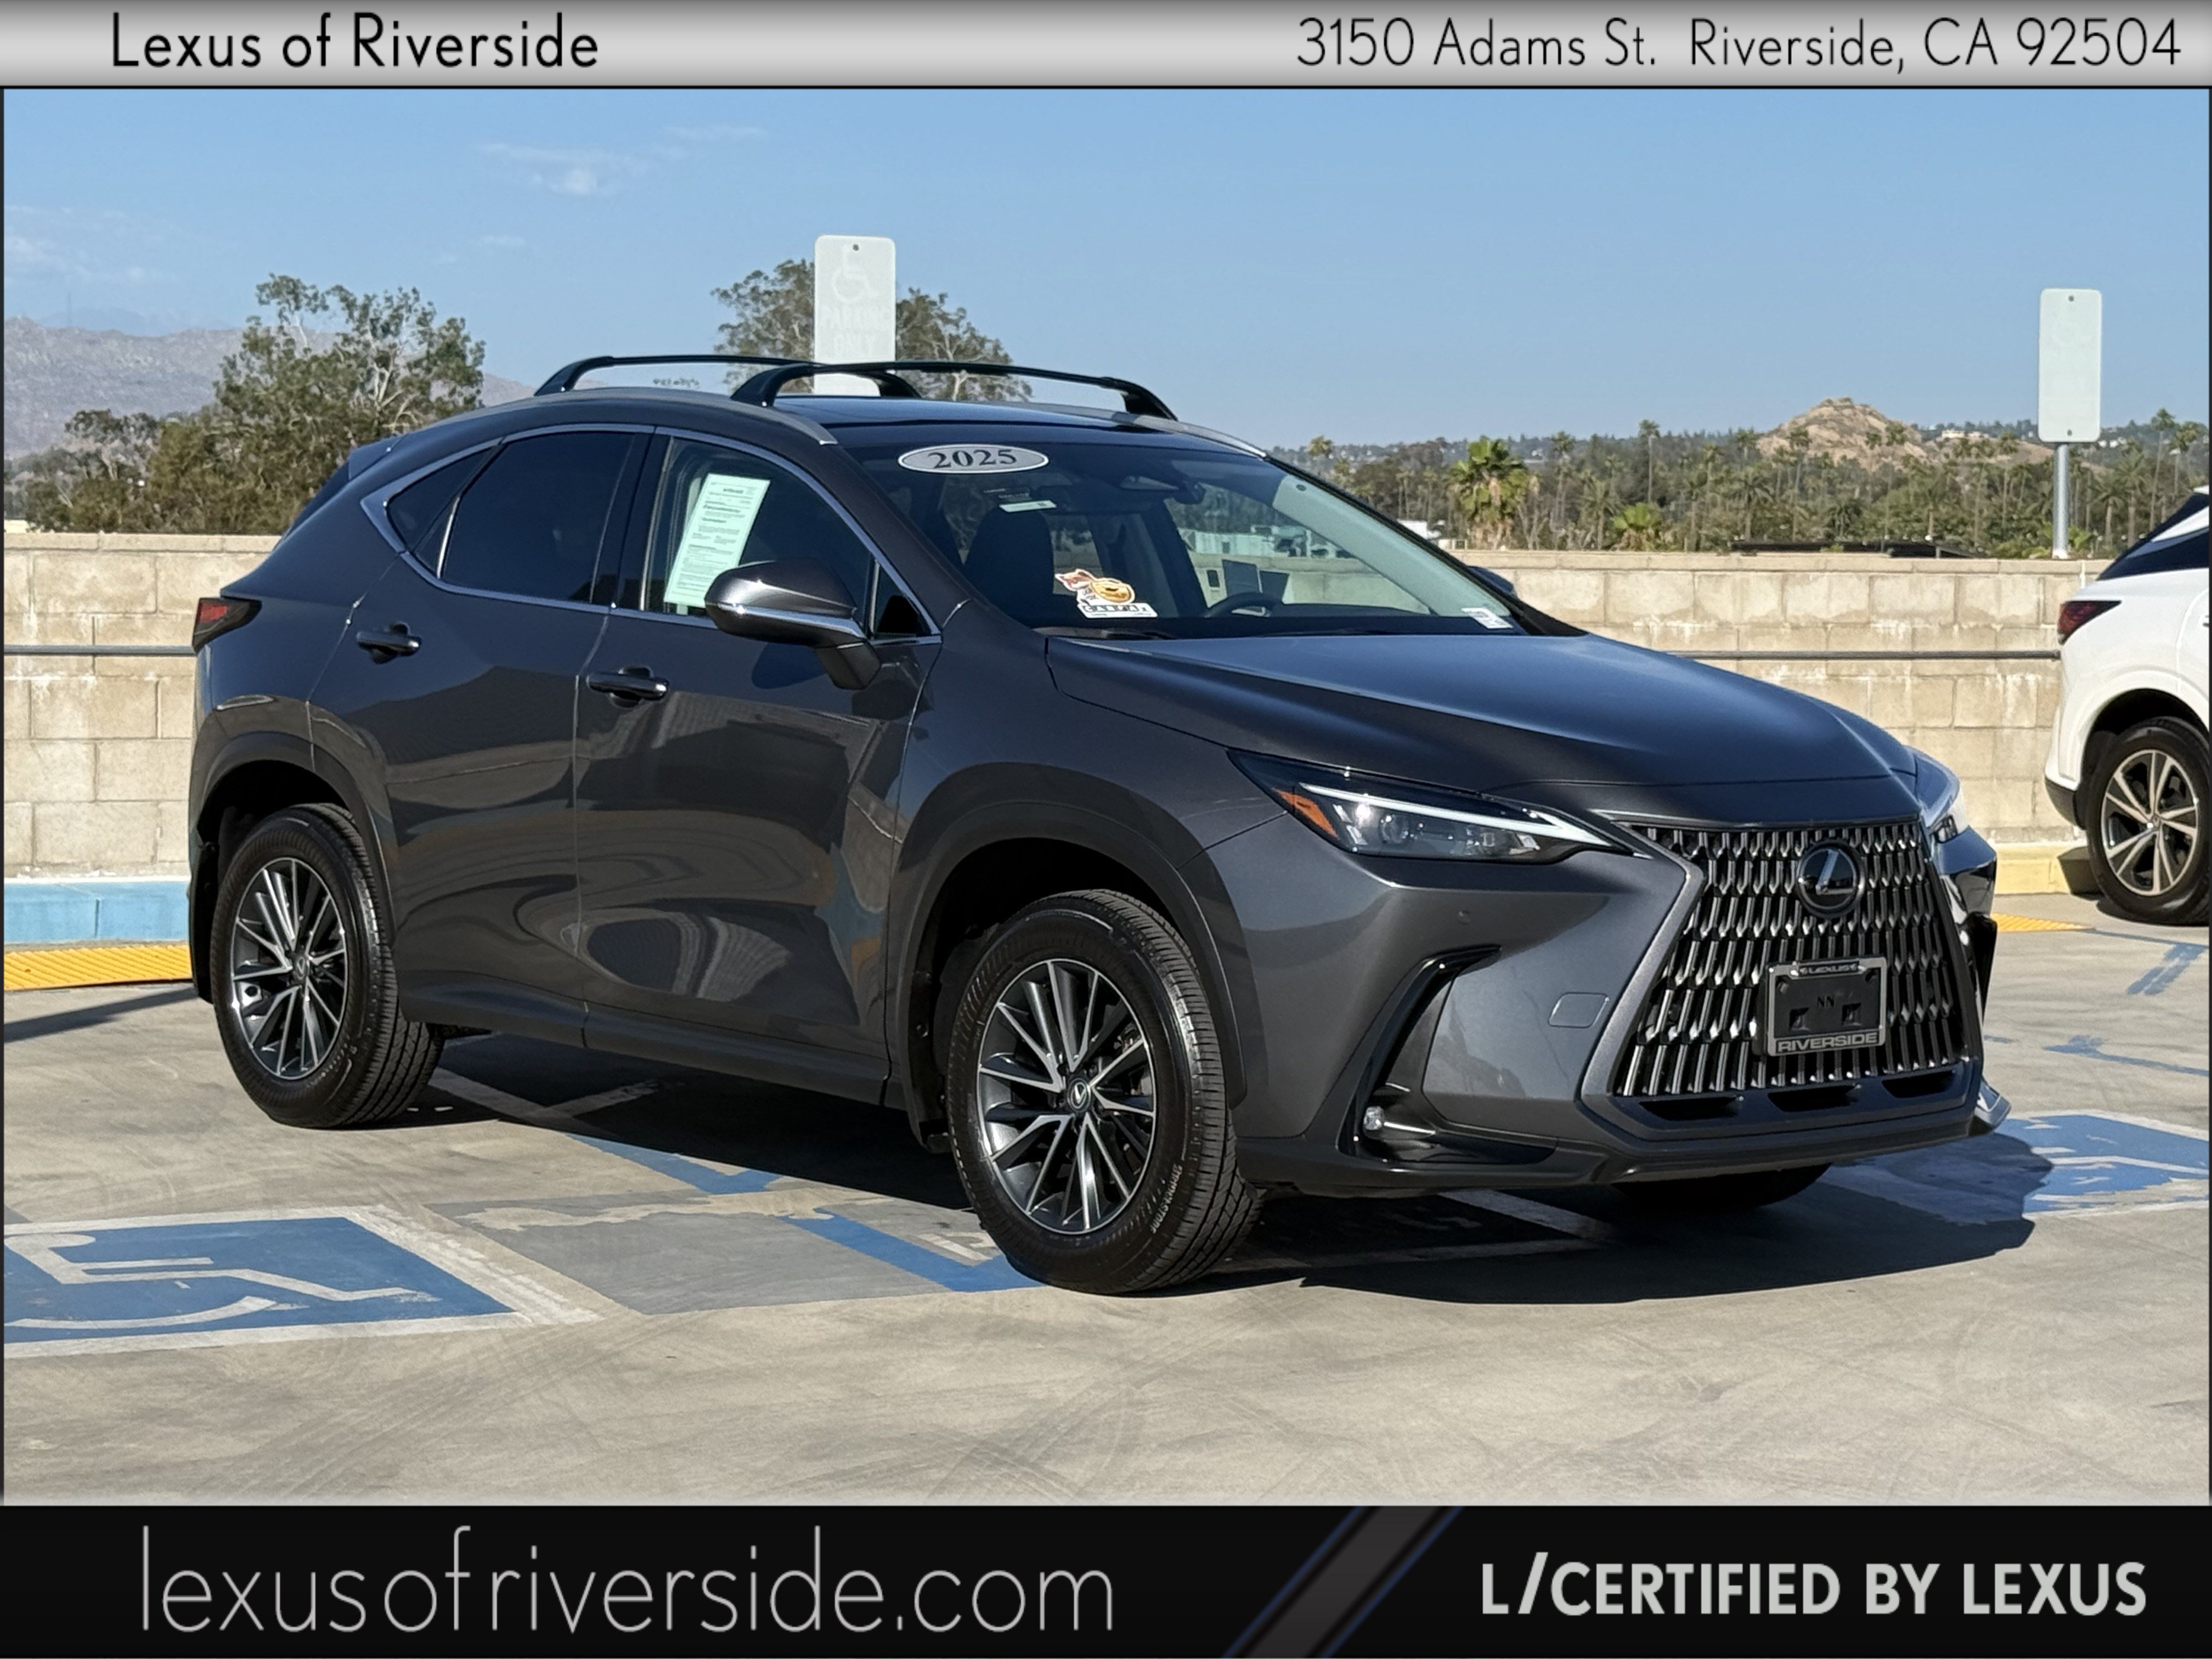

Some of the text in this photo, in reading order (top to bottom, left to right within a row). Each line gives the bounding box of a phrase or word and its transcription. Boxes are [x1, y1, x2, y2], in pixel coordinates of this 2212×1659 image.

[928, 449, 1017, 469] 2025
[1808, 964, 1851, 975] LEXUS
[1778, 1032, 1878, 1052] RIVERSIDE
